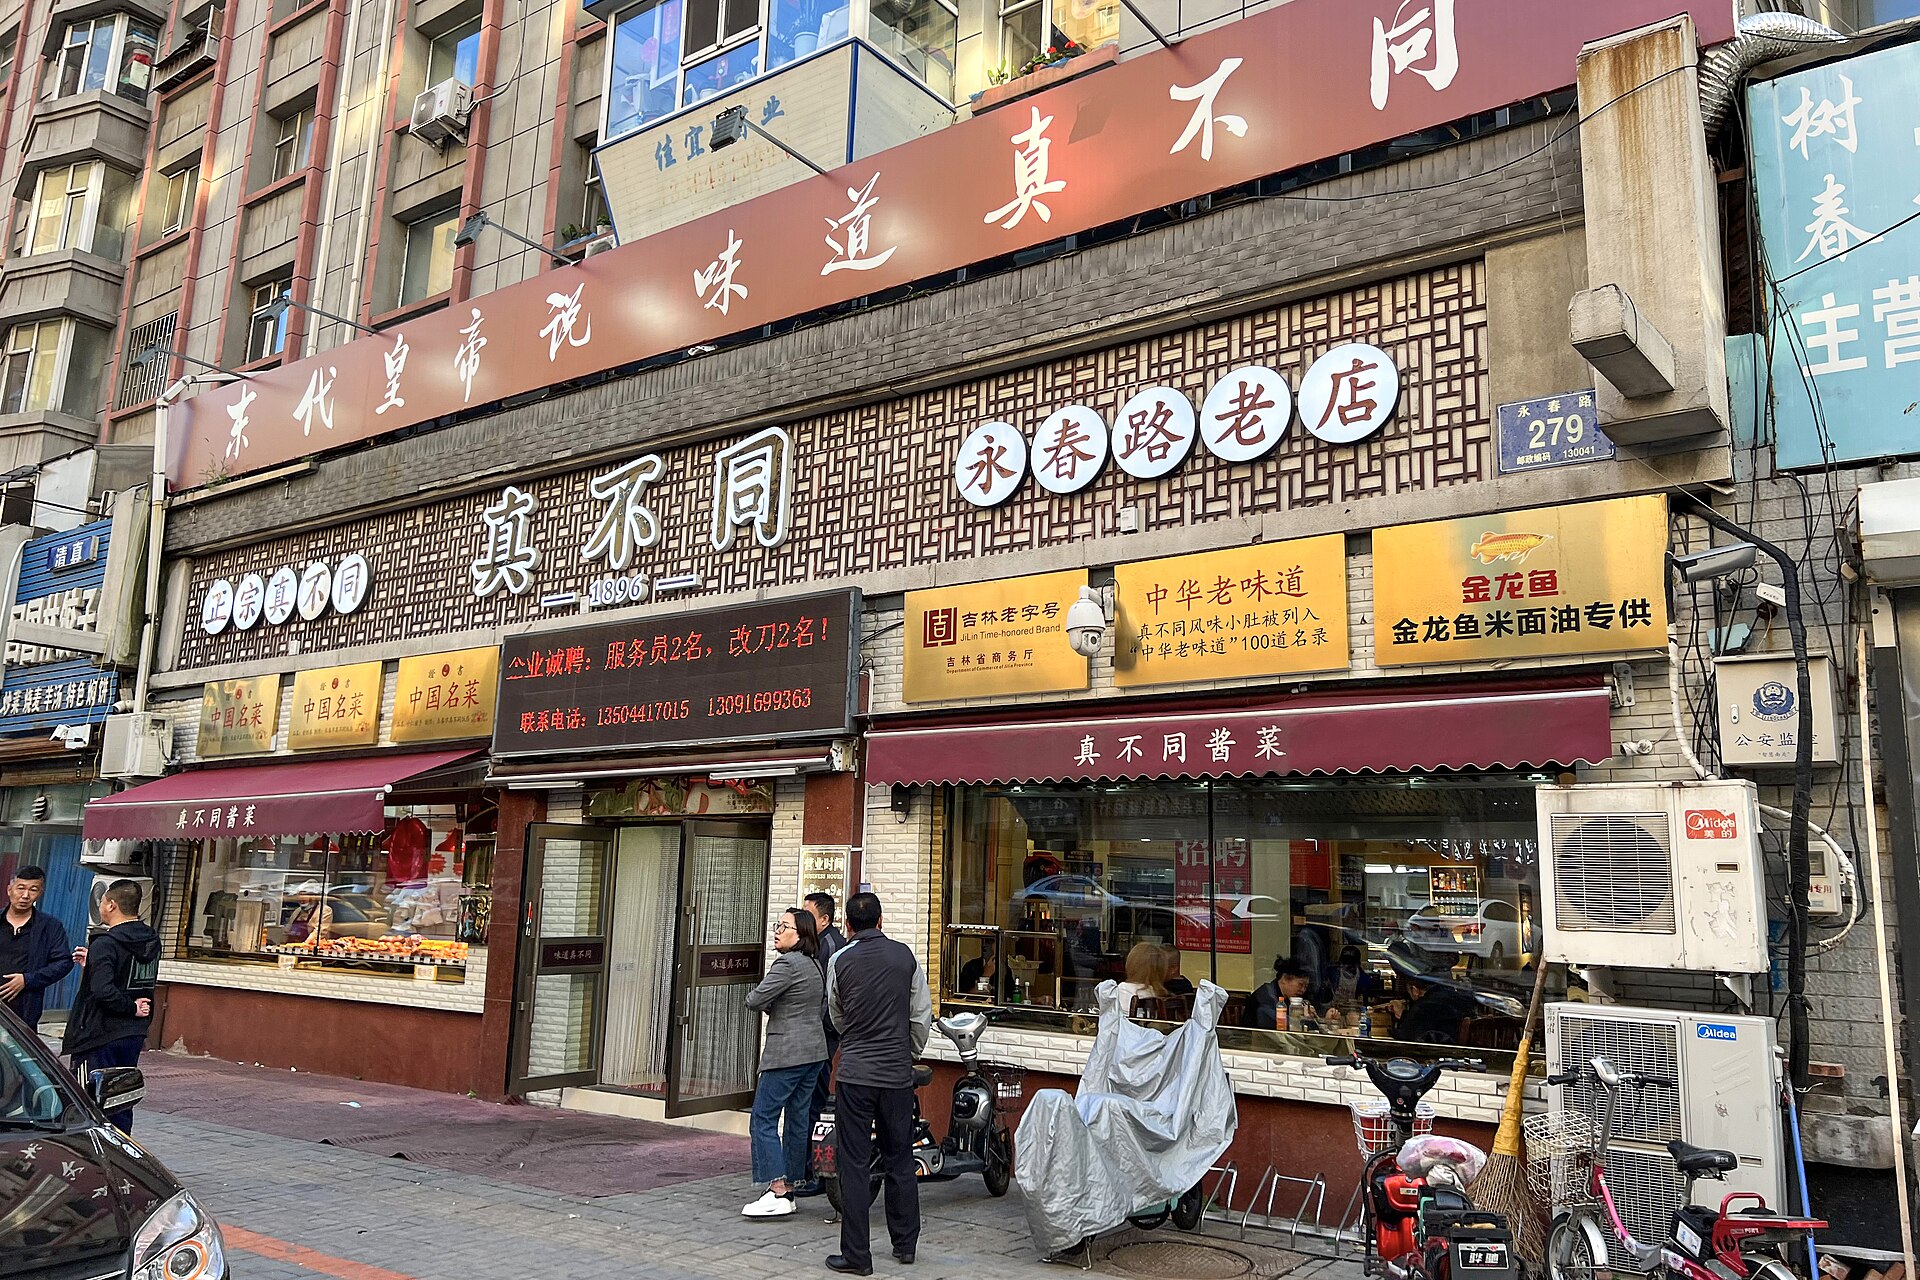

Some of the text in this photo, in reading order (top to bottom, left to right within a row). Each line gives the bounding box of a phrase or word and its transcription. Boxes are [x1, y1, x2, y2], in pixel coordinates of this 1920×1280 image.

[1781, 73, 1884, 264] 树春
[1801, 276, 1920, 377] 主营
[1518, 395, 1592, 418] 永春路
[963, 358, 1379, 495] 永春路老店
[1529, 414, 1583, 449] 279
[1517, 445, 1595, 465] 邮政编码 130041
[472, 426, 795, 599] 真不同
[54, 541, 85, 569] 清真
[205, 561, 362, 625] 正宗真不同
[589, 574, 643, 604] 1896
[1146, 565, 1309, 616] 中华老味道
[1461, 569, 1559, 603] 金龙鱼
[961, 602, 1060, 628] 吉林老字号
[1137, 606, 1320, 642] 真不同风味小肚被列入
[1391, 598, 1652, 645] 金龙鱼米面油专供
[960, 624, 1060, 642] JiLin Time-honored Brand
[946, 649, 1033, 667] 吉林省商务厅
[303, 692, 364, 724] 中国名菜
[409, 679, 480, 714] 中国名菜
[707, 688, 812, 717] 13091699363
[211, 702, 264, 731] 中国名菜
[1074, 725, 1287, 768] 真不同酱菜
[175, 804, 257, 829] 真不同酱菜
[804, 857, 844, 872] 营业时间
[553, 949, 592, 960] 味道真不同
[711, 957, 749, 970] 味道真不同
[1698, 1024, 1736, 1039] Midea
